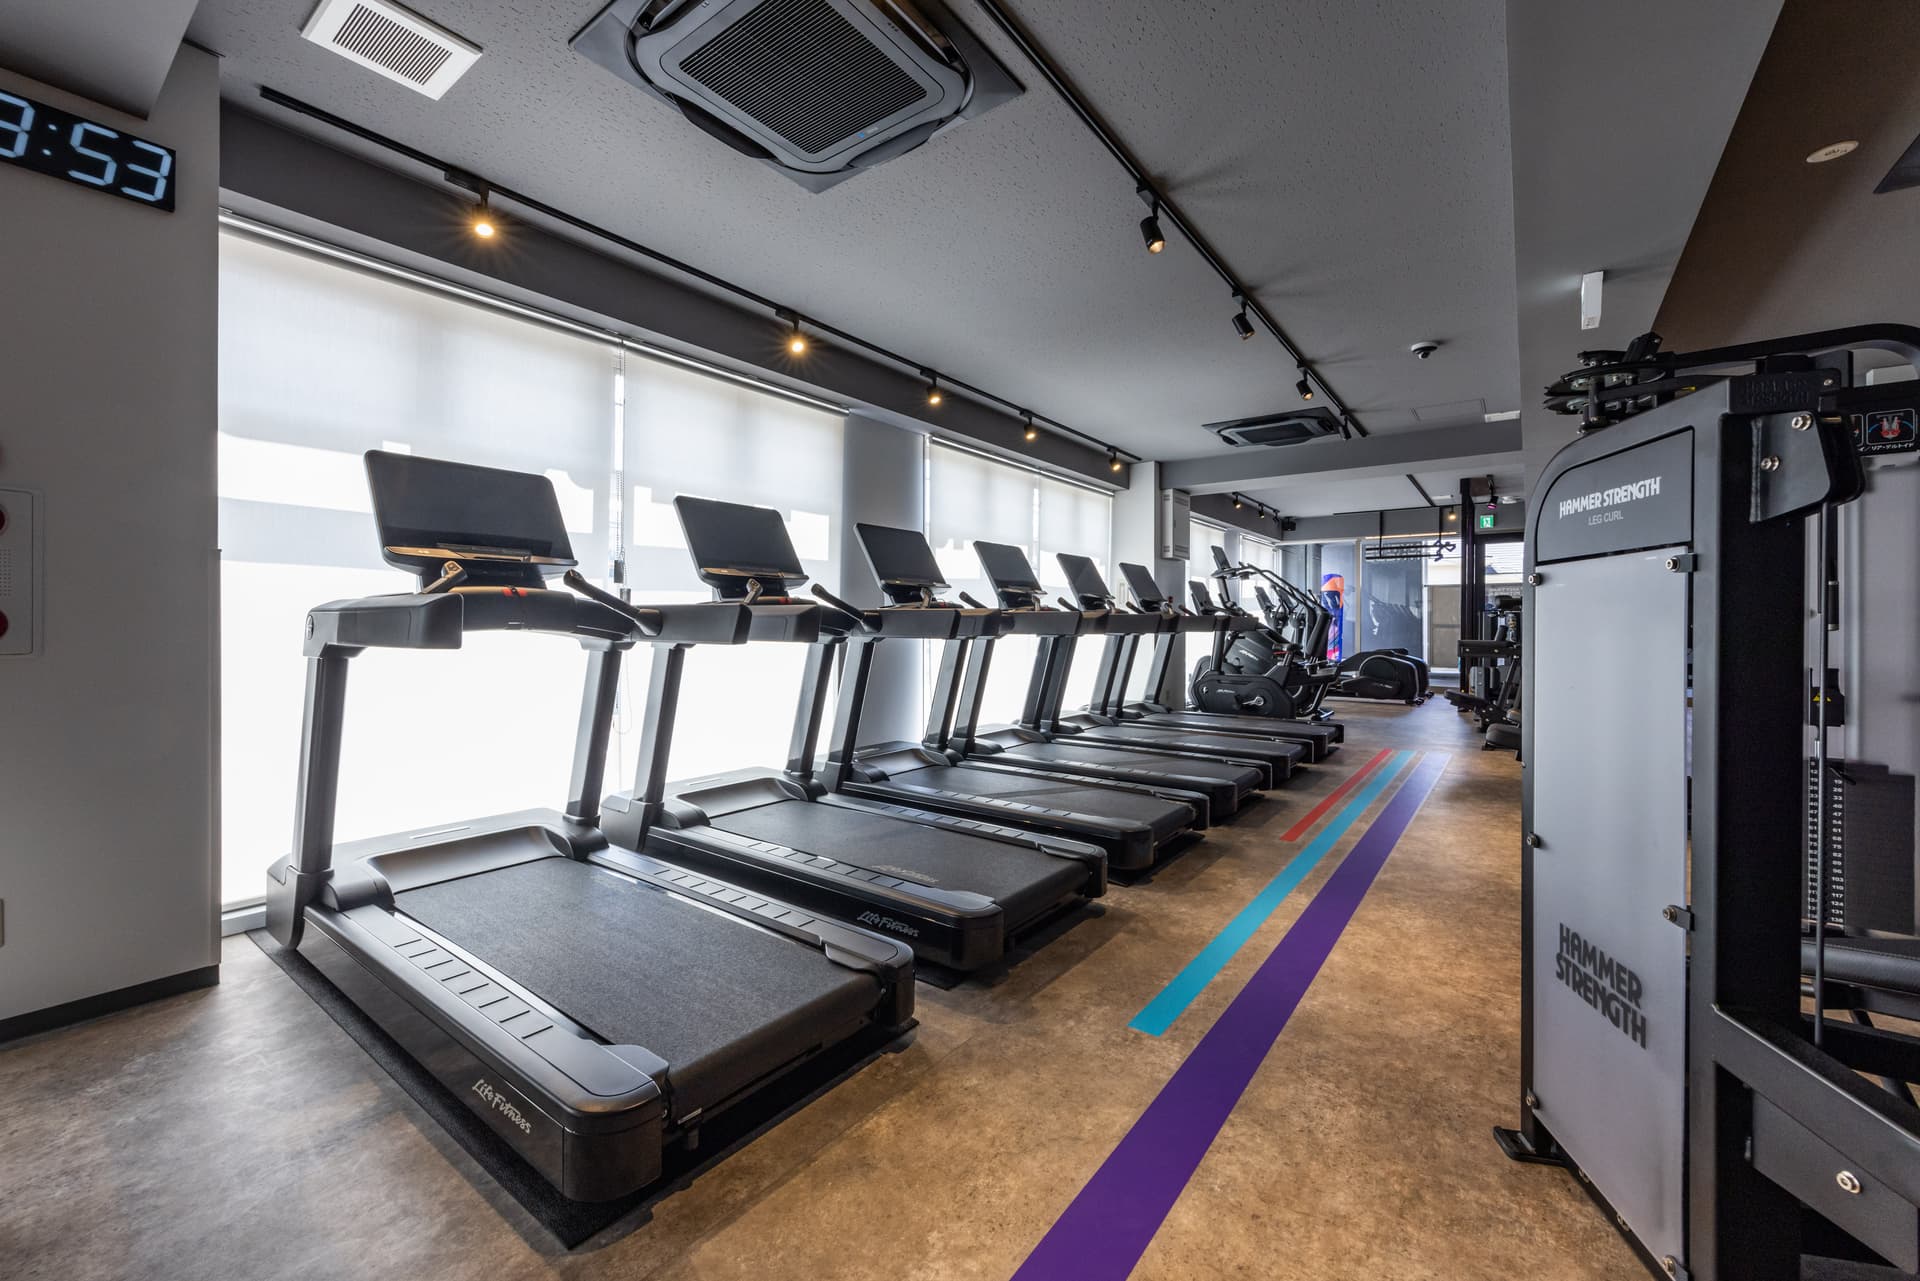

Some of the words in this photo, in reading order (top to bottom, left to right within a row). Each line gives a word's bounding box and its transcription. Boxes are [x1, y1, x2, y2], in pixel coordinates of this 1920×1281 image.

[1559, 492, 1602, 519] HAMMER
[1603, 476, 1662, 507] STRENGTH
[1588, 514, 1602, 526] LEG
[1604, 510, 1624, 523] CURL
[1559, 922, 1642, 1010] HAMMER
[1555, 951, 1647, 1050] STRENGTH
[472, 1079, 495, 1102] Life
[492, 1093, 531, 1134] Fitness
